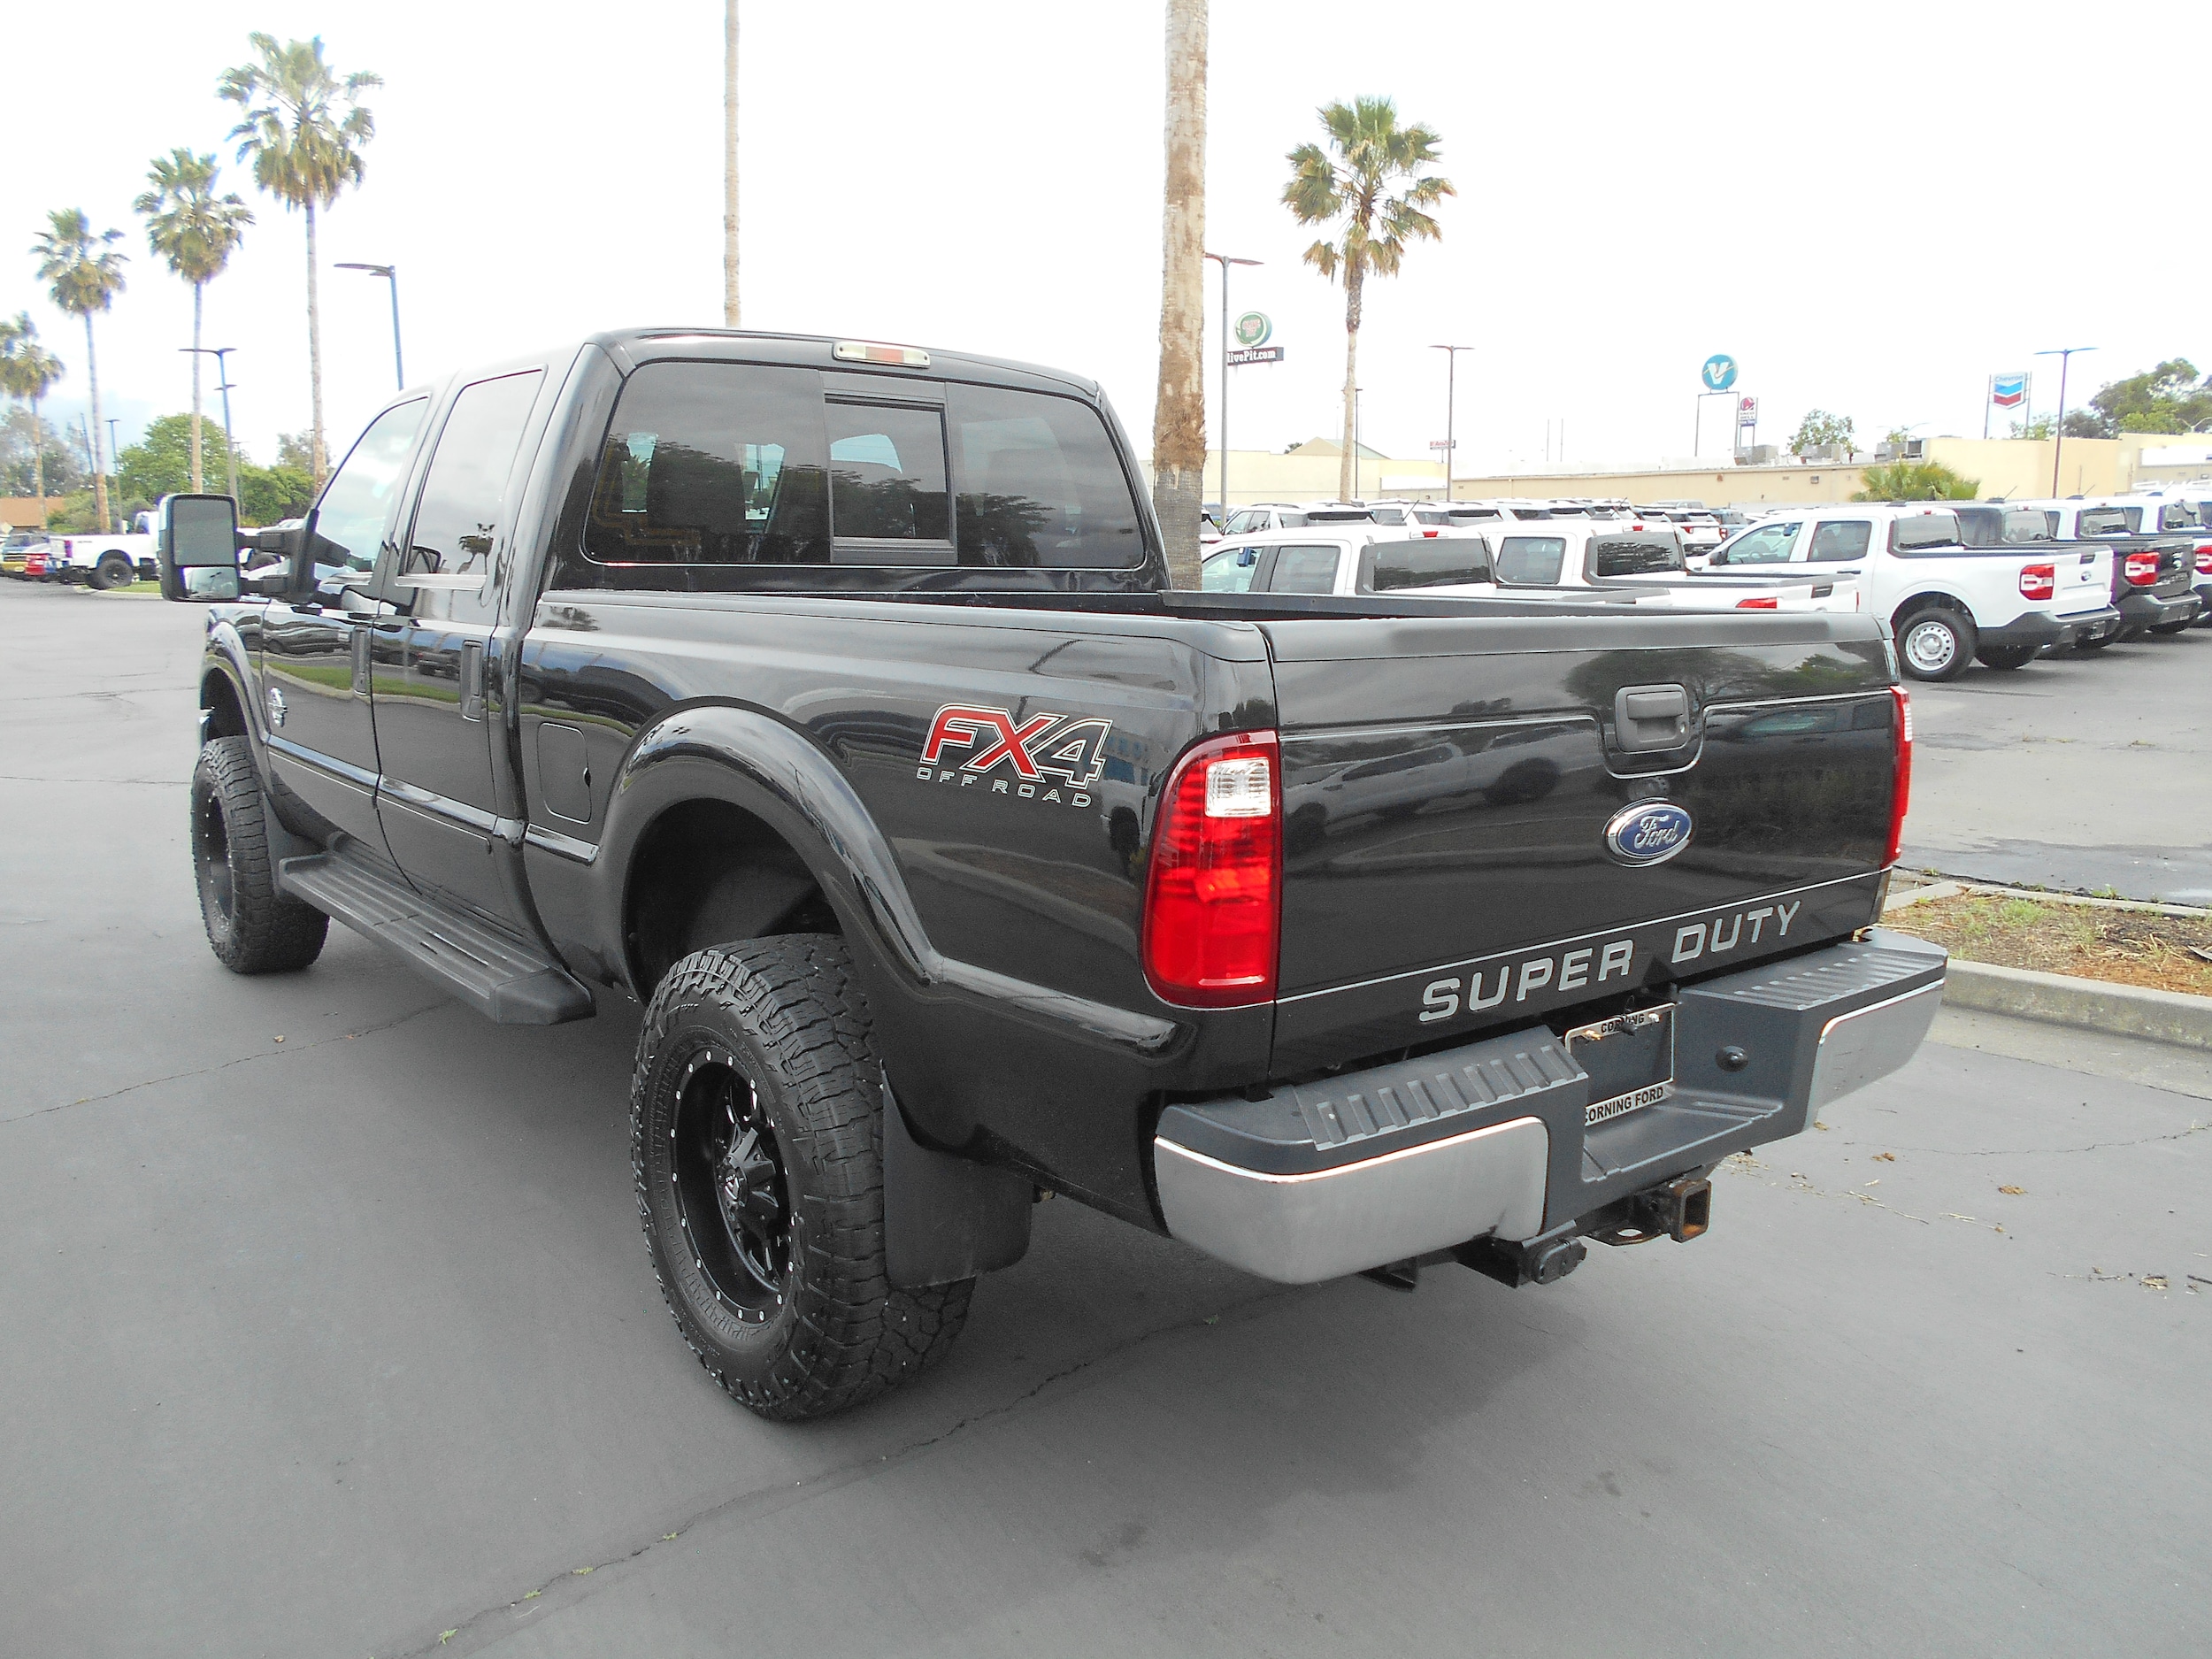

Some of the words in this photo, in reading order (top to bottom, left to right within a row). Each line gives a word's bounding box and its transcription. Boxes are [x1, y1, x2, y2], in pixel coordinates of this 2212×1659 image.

[1227, 350, 1276, 363] livePit.com
[919, 703, 1114, 790] FX4
[916, 766, 978, 787] OFF
[991, 779, 1093, 808] ROAD
[1633, 815, 1680, 849] Ford
[1417, 938, 1635, 1023] SUPER
[1670, 900, 1802, 964] DUTY
[1635, 1087, 1663, 1107] FORD
